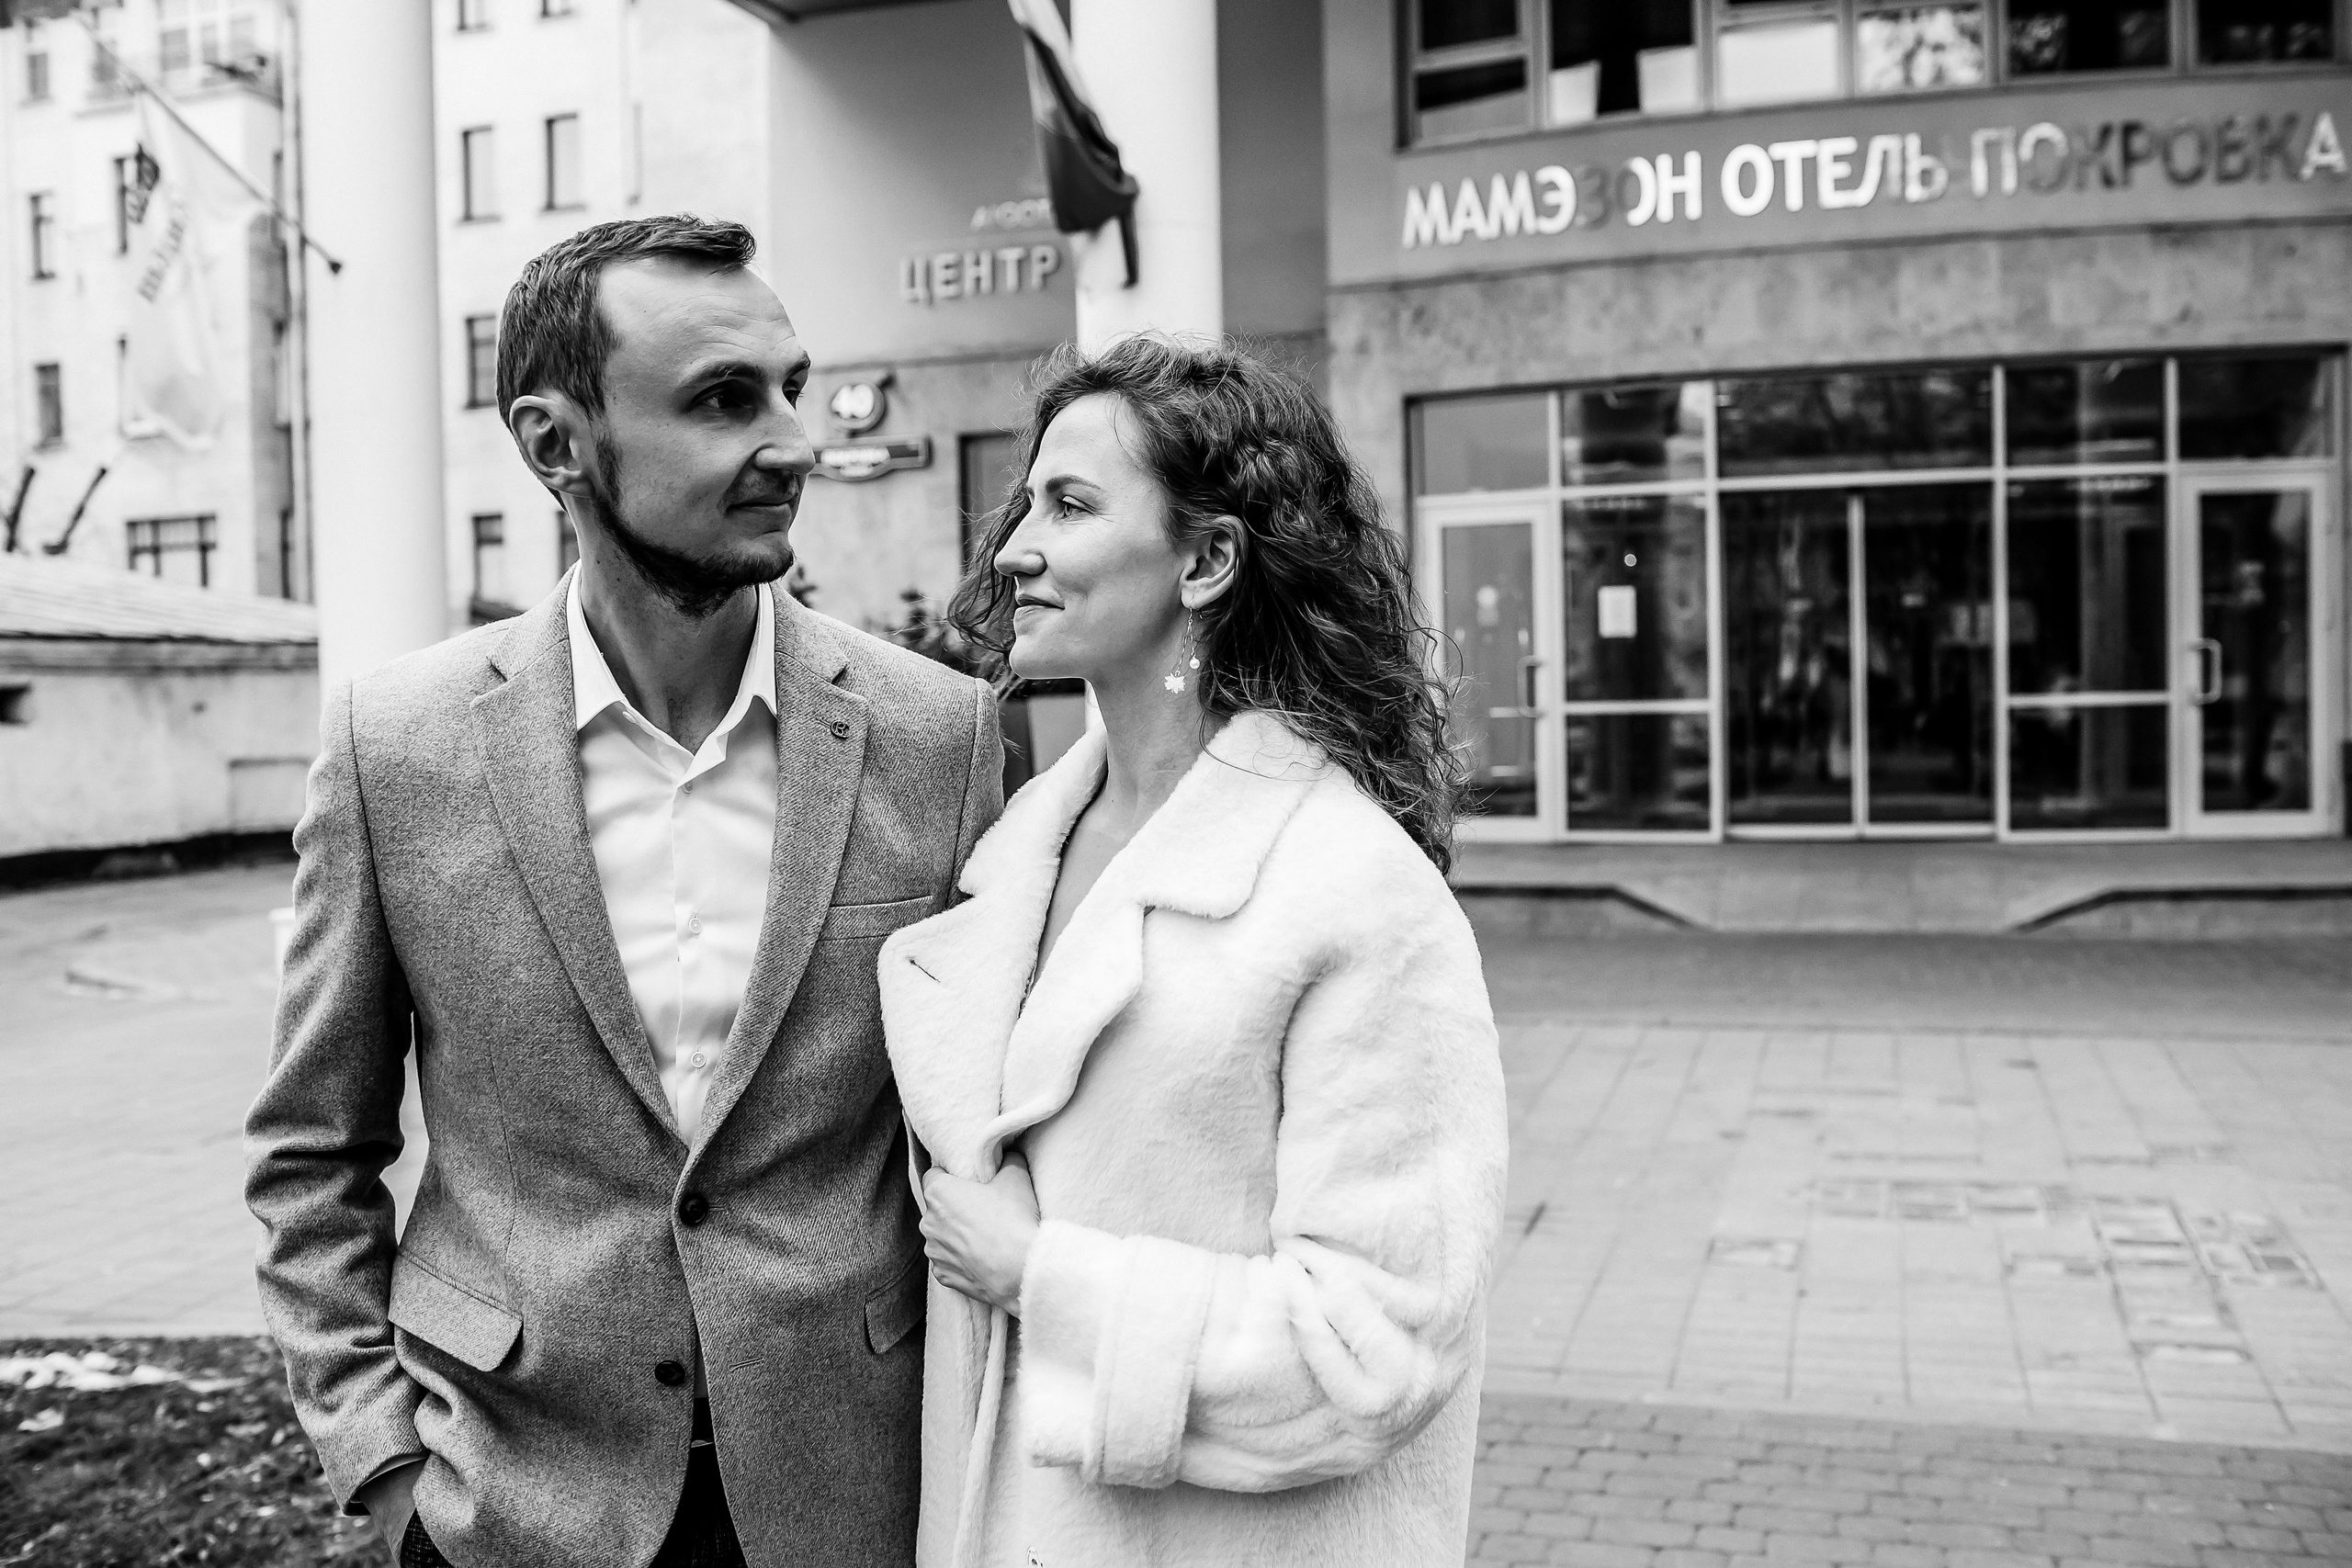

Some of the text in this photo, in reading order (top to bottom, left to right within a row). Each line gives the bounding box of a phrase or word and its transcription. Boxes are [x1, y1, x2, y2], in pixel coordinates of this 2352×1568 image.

[1401, 110, 2346, 249] МАМЭЗОН ОТЕЛЬ ПОКРОВКА
[900, 243, 1060, 305] ЦЕНТР
